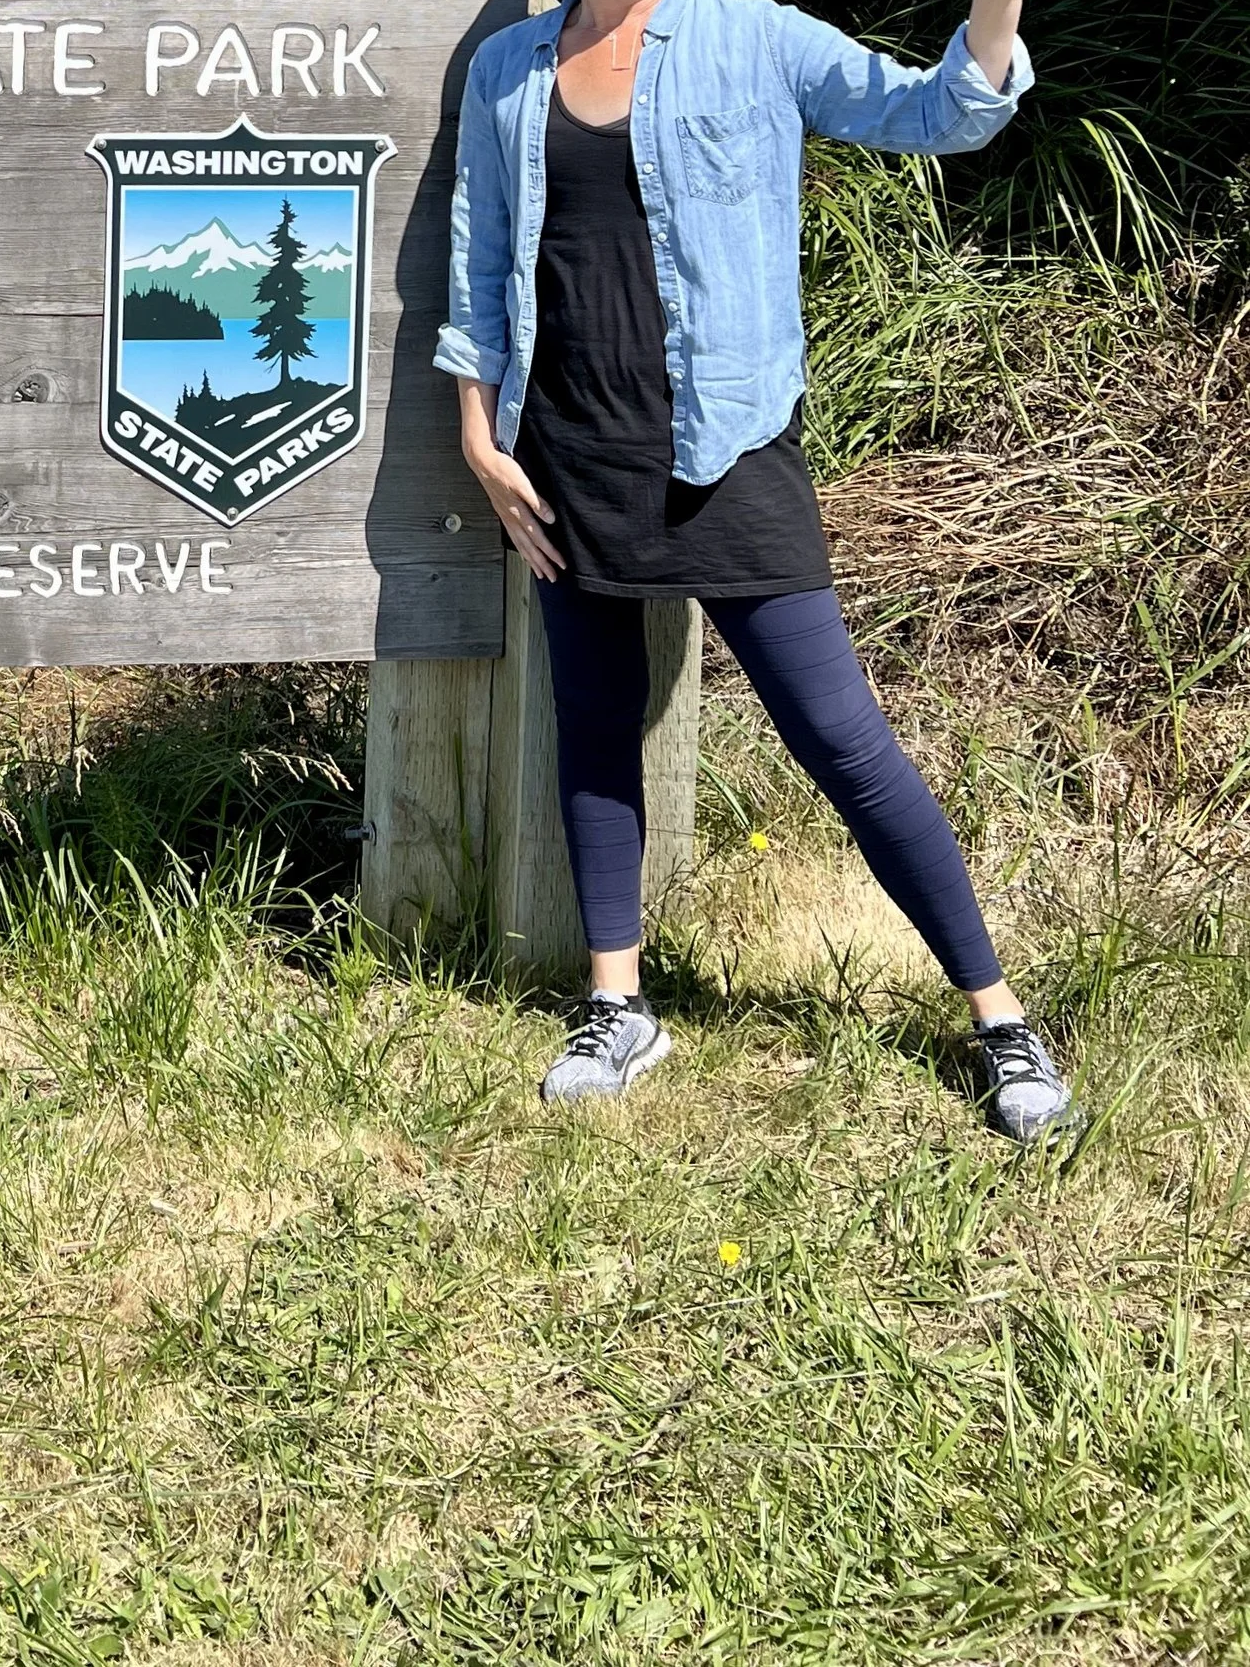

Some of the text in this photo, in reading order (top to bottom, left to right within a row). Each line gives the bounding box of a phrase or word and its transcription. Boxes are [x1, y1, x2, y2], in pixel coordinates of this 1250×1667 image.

[144, 21, 387, 97] PARK
[114, 149, 364, 176] WASHINGTON
[114, 406, 355, 498] STATE PARKS
